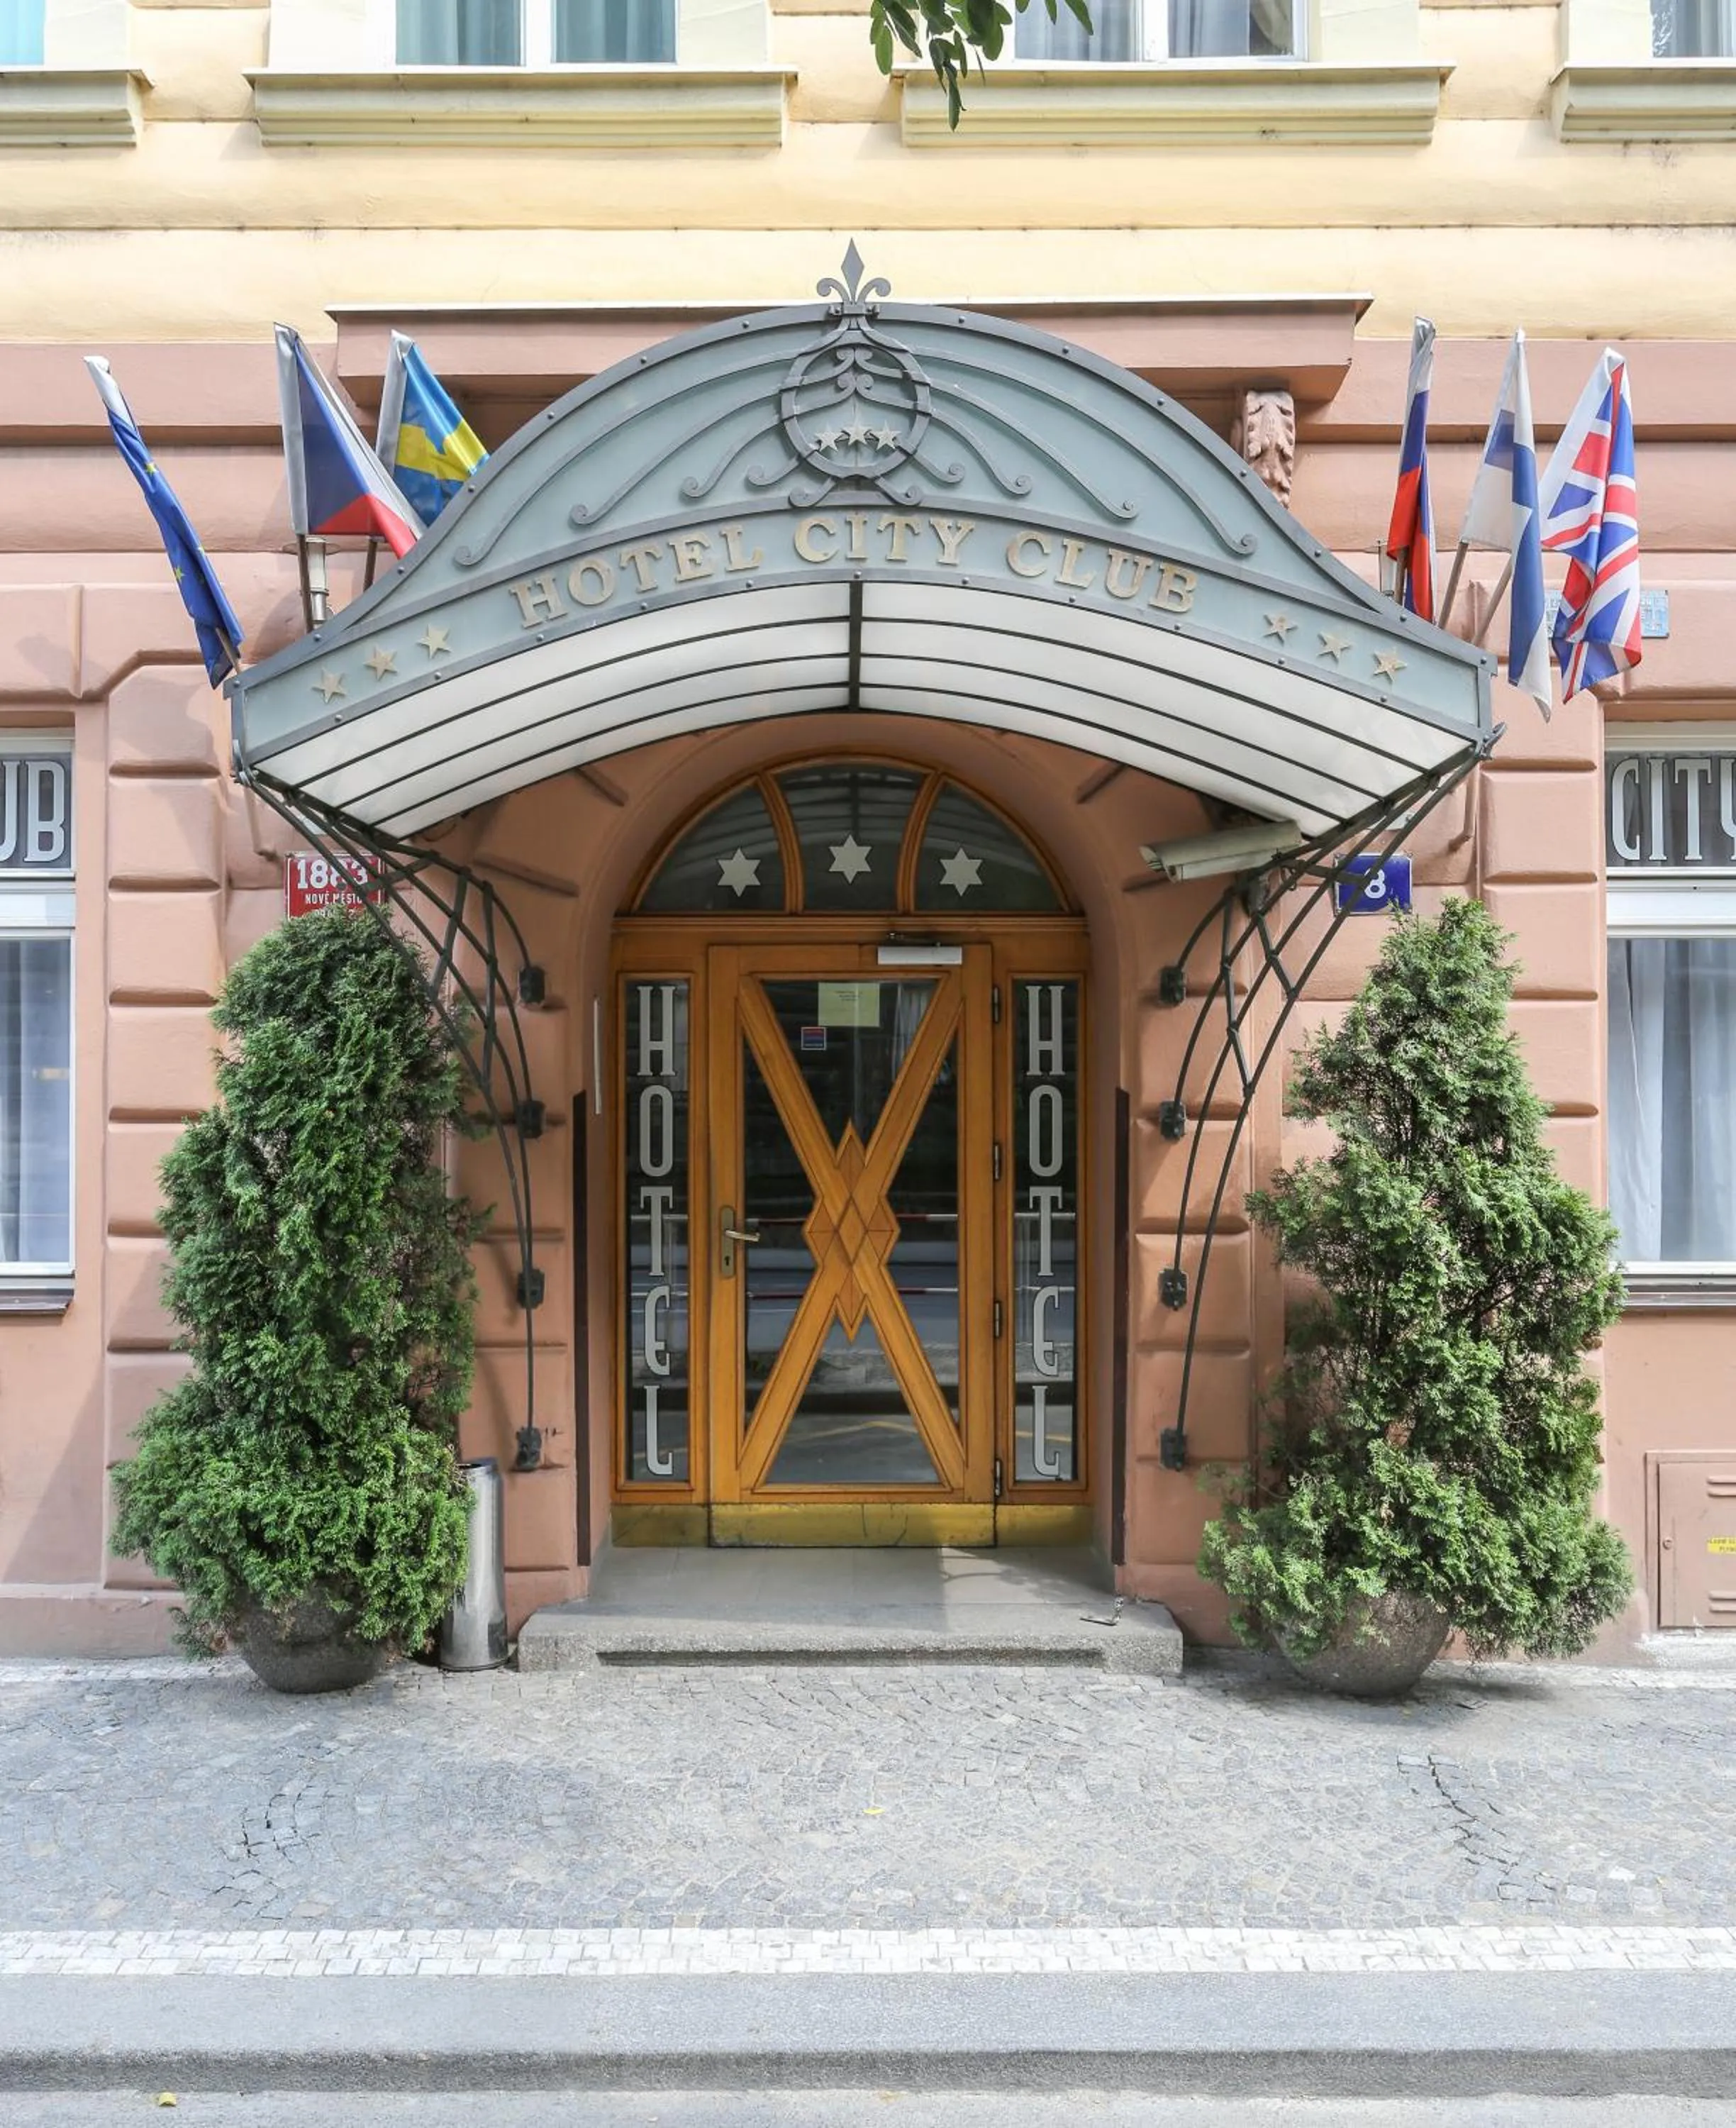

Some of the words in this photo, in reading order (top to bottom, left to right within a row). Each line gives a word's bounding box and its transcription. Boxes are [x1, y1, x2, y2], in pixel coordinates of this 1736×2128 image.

[508, 525, 764, 628] HOTEL
[794, 514, 975, 565] CITY
[1006, 529, 1200, 615] CLUB
[305, 890, 330, 905] NOVÉ
[637, 985, 676, 1475] HOTEL
[1025, 985, 1066, 1476] HOTEL
